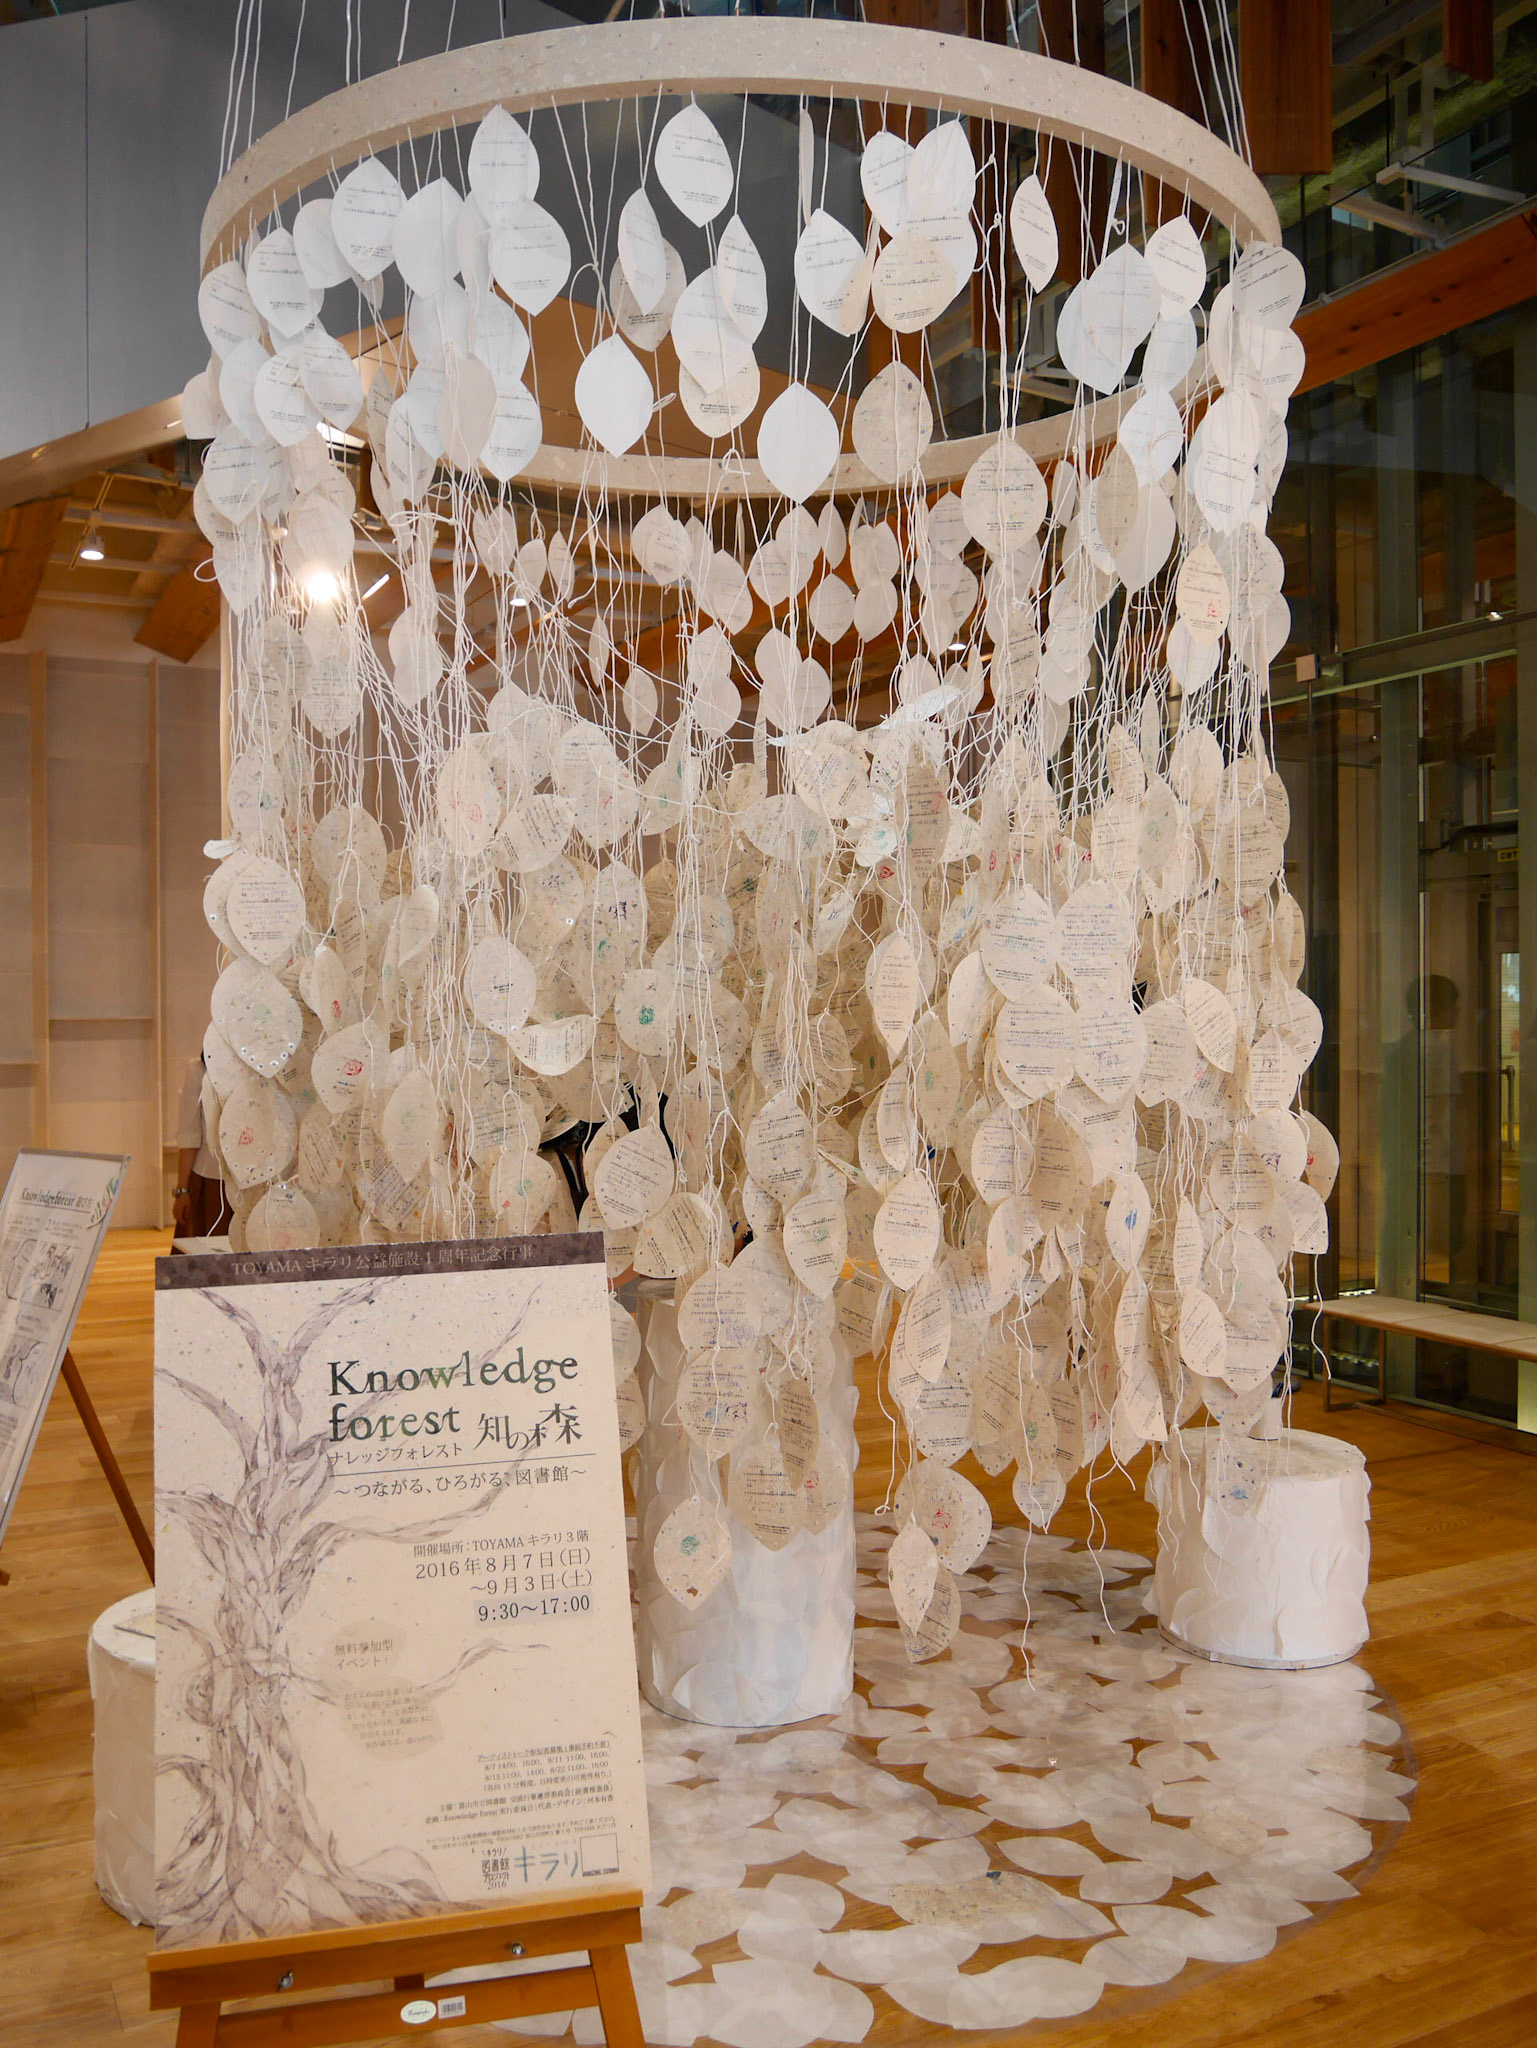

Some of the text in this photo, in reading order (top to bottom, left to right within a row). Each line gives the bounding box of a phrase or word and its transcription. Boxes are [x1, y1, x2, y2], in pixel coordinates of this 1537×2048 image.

[327, 1346, 579, 1396] Knowledge
[328, 1403, 583, 1450] forest 知の森
[330, 1442, 463, 1466] ナレッジフォレスト
[335, 1639, 393, 1656] 無料参加型
[481, 1857, 510, 1874] 図書館
[514, 1846, 579, 1883] キラリ
[487, 1880, 508, 1891] 2016
